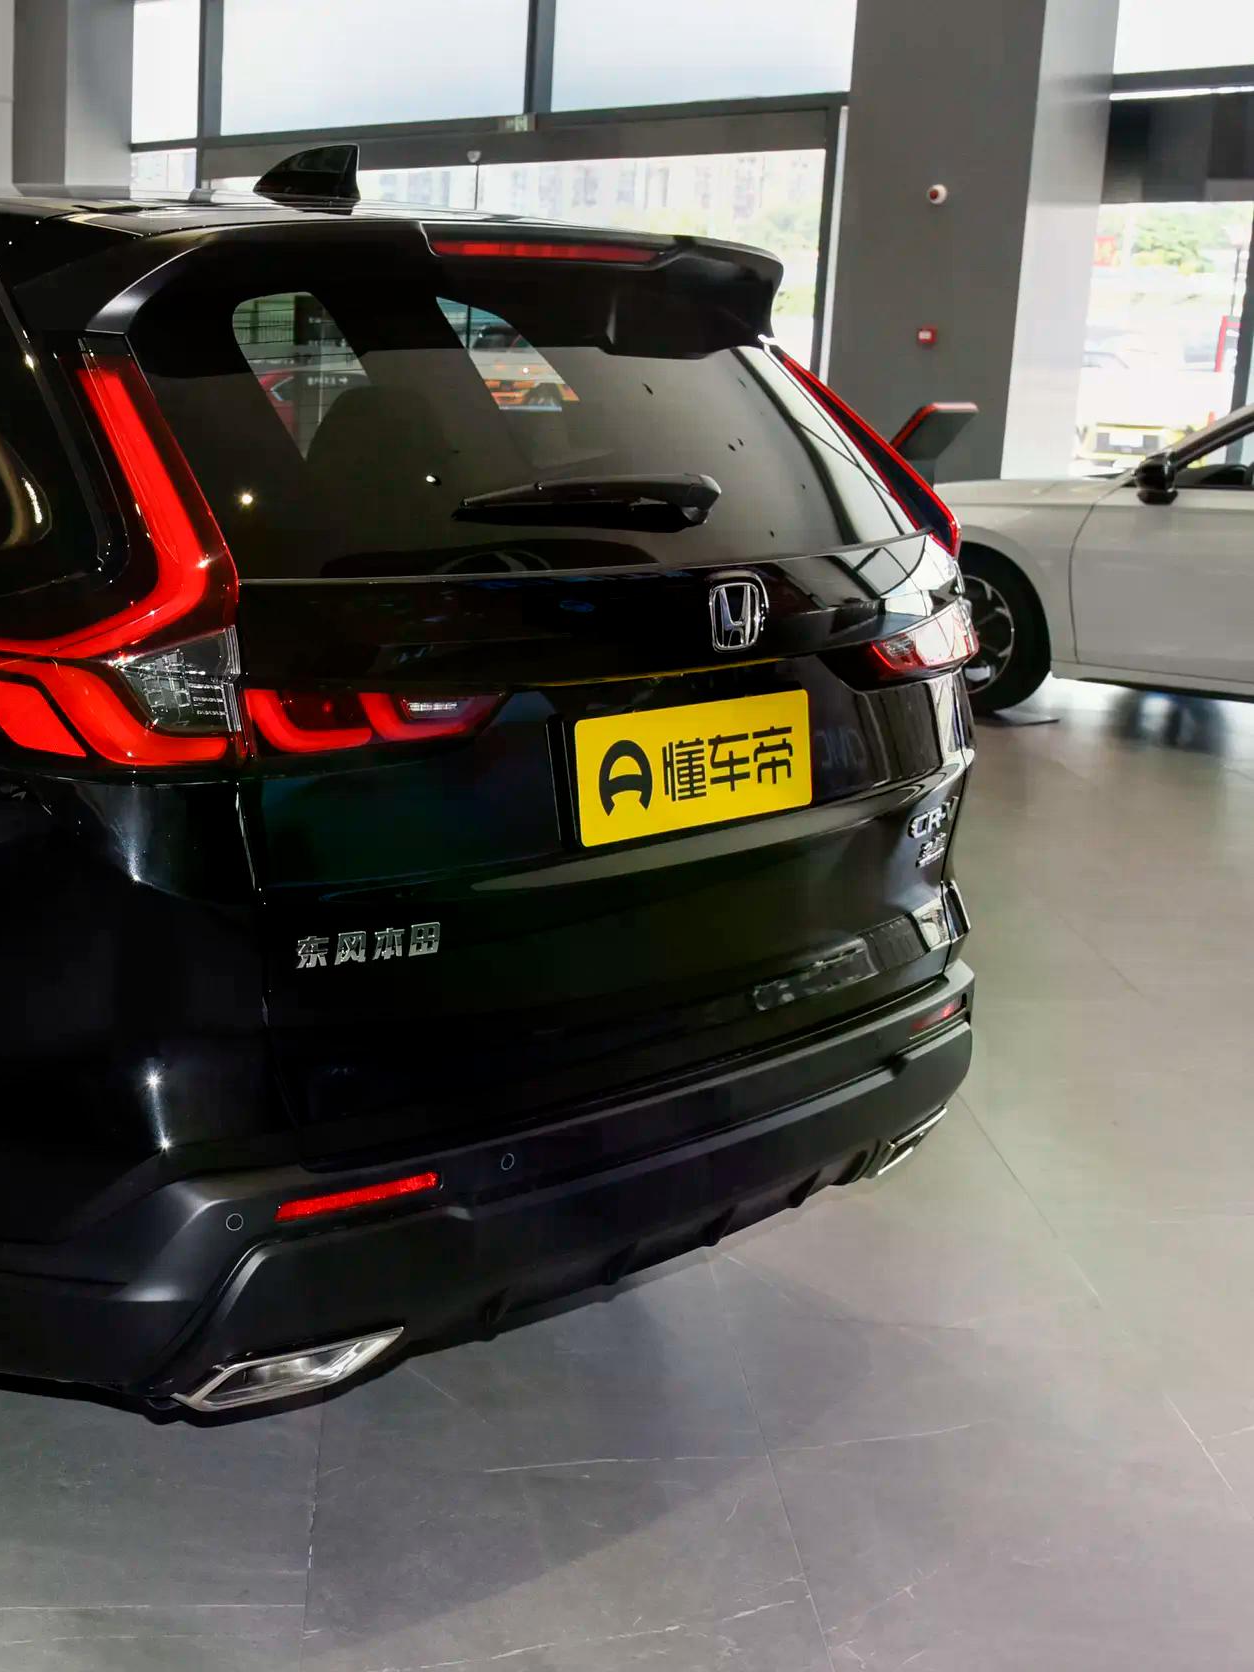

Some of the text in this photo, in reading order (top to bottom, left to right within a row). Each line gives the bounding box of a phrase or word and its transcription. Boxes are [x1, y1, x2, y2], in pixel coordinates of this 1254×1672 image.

[662, 726, 794, 802] 懂车帝
[909, 796, 959, 839] CR-V
[296, 921, 441, 969] 东风本田
